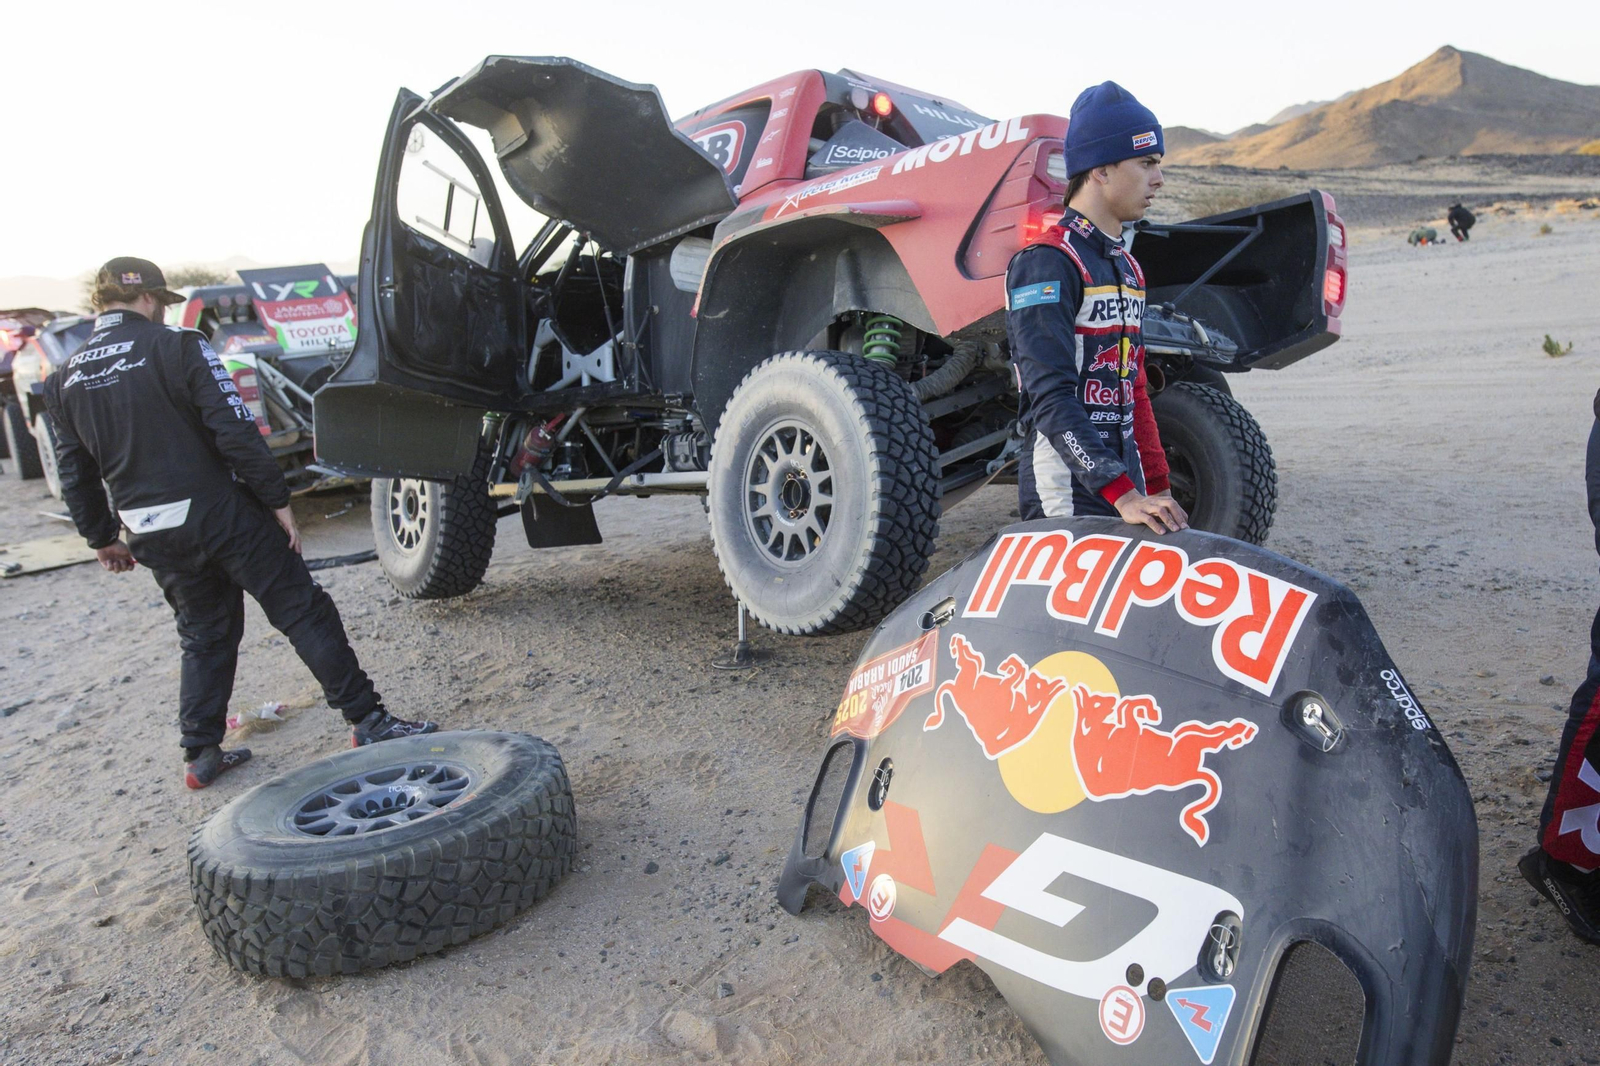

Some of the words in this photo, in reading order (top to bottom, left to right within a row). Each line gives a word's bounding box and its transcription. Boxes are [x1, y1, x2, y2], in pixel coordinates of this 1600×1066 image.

[892, 116, 1031, 176] MOTUL
[1134, 135, 1155, 145] REPSOL
[287, 325, 348, 339] TOYOTA
[1062, 431, 1096, 471] sparco
[848, 663, 885, 694] ARABIA
[888, 648, 919, 677] SAUDI
[900, 664, 923, 692] 204
[835, 689, 868, 726] 2025
[1380, 669, 1431, 730] sparco
[1543, 877, 1571, 915] sparco
